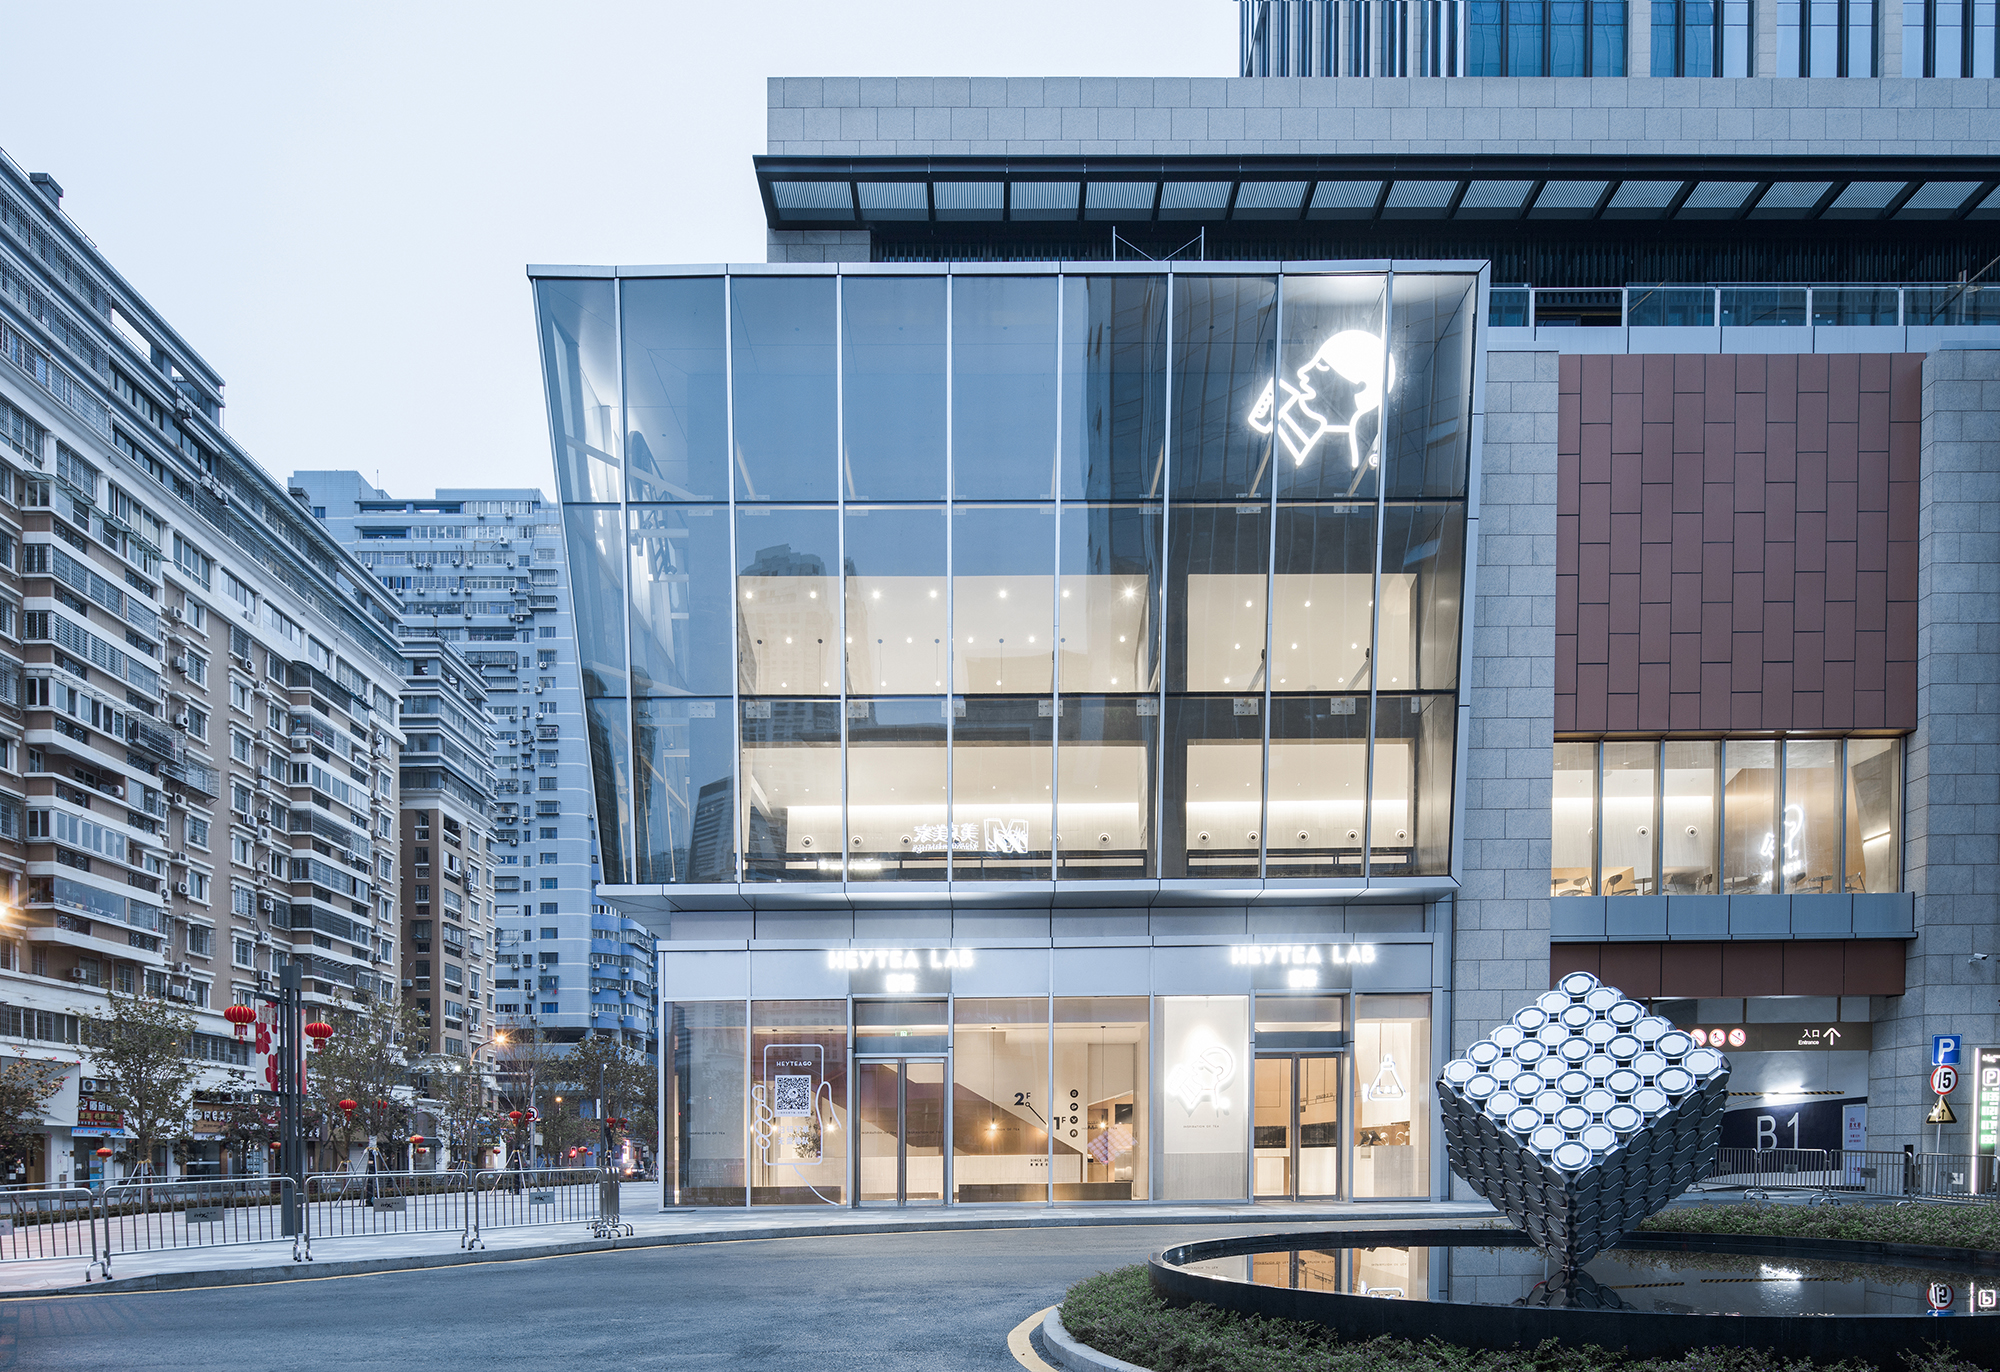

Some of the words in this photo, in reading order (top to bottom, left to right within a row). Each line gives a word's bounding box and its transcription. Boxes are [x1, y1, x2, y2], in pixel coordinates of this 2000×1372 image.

[828, 950, 919, 969] HEYTEA
[930, 949, 974, 968] LAB
[1231, 945, 1321, 964] HEYTEA
[1333, 945, 1375, 963] LAB
[1802, 1029, 1820, 1038] 入口
[1938, 1038, 1955, 1062] P
[1014, 1092, 1031, 1106] 2F
[1053, 1116, 1066, 1130] 1F
[1757, 1112, 1799, 1153] B1
